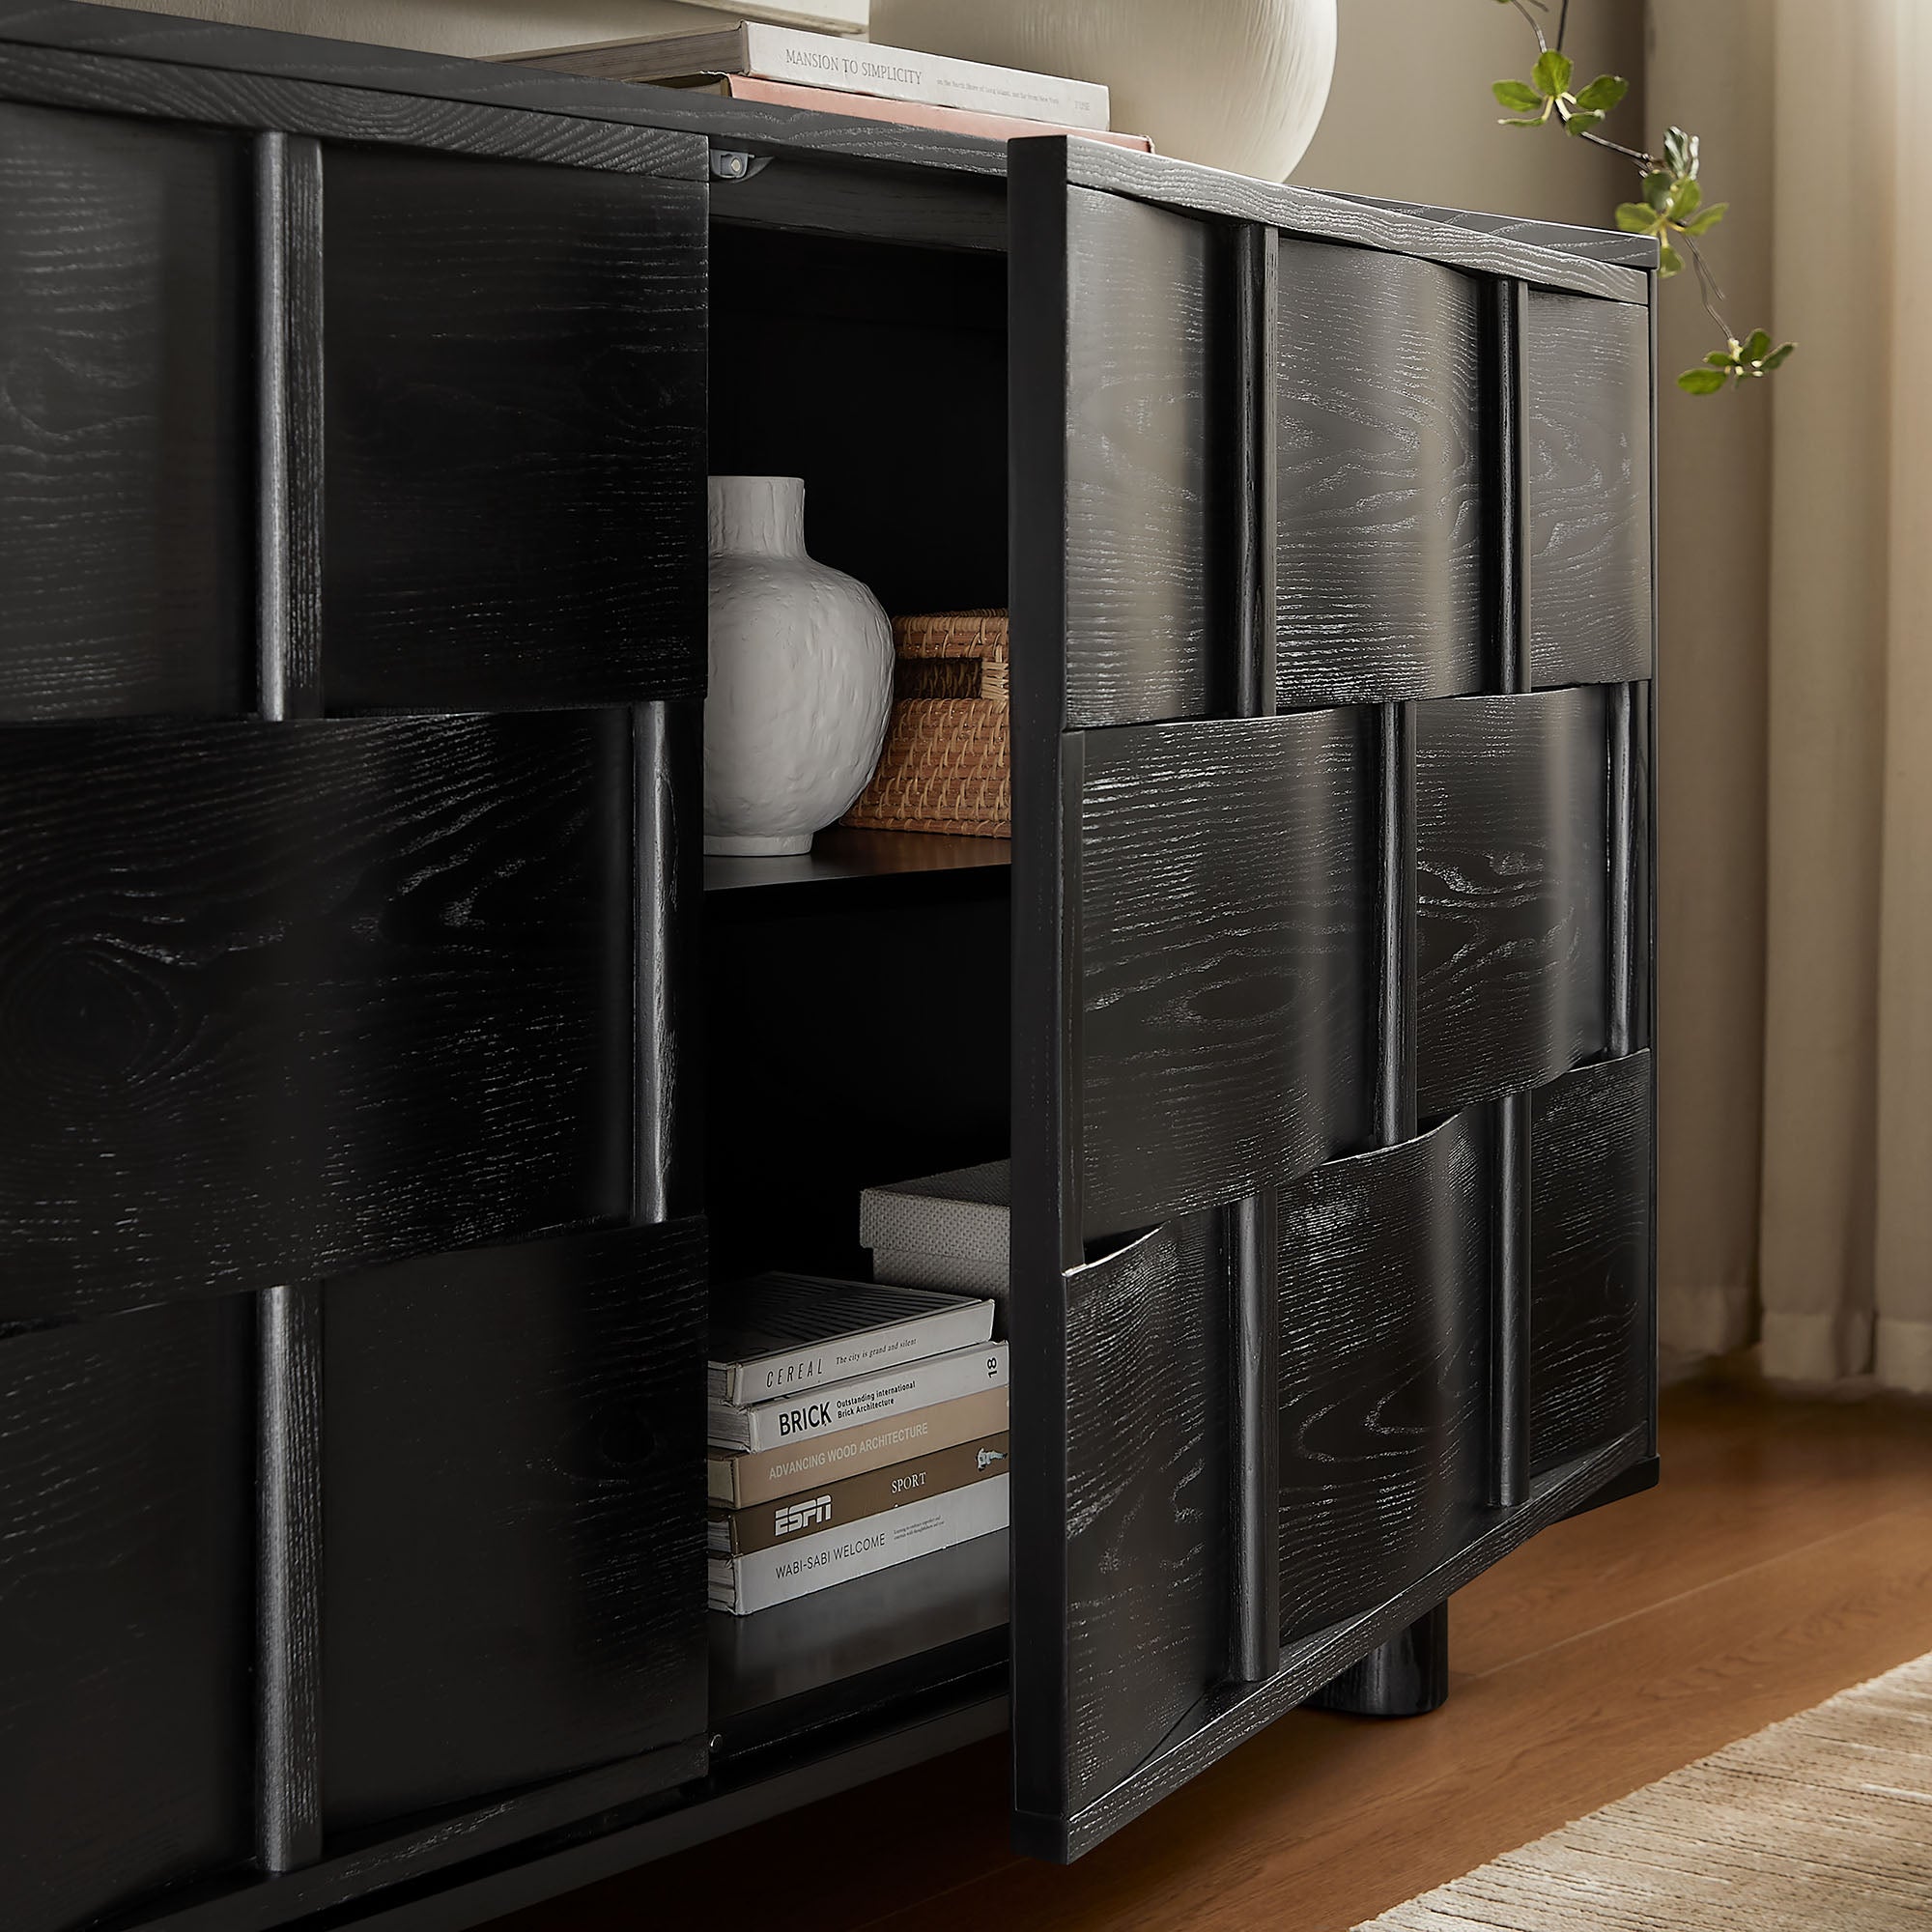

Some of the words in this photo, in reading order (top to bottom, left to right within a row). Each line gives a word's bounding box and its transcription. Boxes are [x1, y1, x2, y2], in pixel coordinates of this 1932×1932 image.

[785, 49, 838, 71] MANSION
[842, 58, 859, 74] TO
[862, 62, 923, 85] SIMPLICITY
[836, 1356, 847, 1365] The
[848, 1352, 860, 1362] city
[869, 1345, 887, 1358] grand
[888, 1343, 899, 1351] and
[899, 1338, 917, 1349] silent
[766, 1358, 823, 1388] CEREAL
[987, 1357, 998, 1378] 18
[837, 1391, 875, 1408] Outstanding
[876, 1380, 916, 1398] international
[838, 1407, 855, 1419] Brick
[855, 1398, 895, 1414] Architecture
[779, 1402, 833, 1436] BRICK
[769, 1453, 826, 1480] ADVANCING
[827, 1442, 858, 1463] WOOD
[859, 1422, 928, 1454] ARCHITECTURE
[892, 1471, 926, 1494] SPORT
[775, 1494, 833, 1537] ESPN
[775, 1549, 831, 1579] WABI-SABI
[833, 1532, 886, 1560] WELCOME
